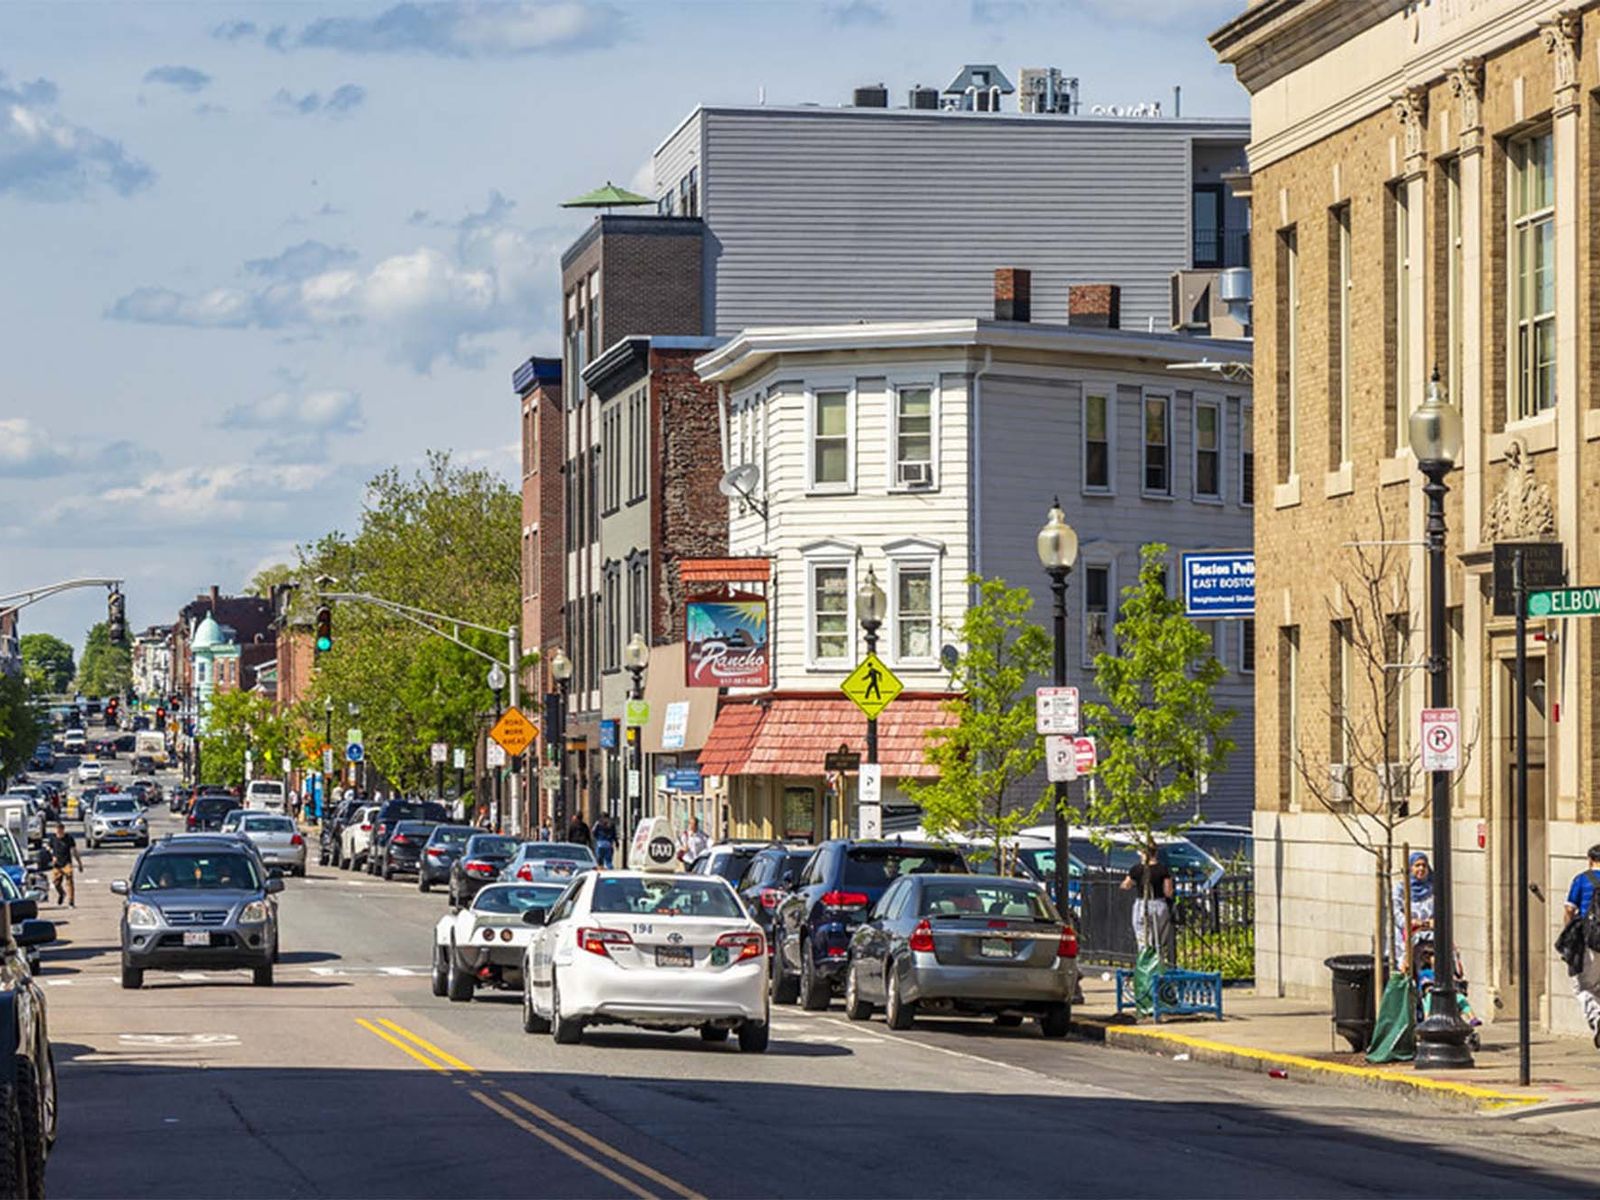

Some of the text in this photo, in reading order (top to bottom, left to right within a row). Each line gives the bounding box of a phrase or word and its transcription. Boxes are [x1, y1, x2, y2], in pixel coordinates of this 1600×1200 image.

[1192, 563, 1230, 575] Boston
[1192, 578, 1217, 589] EAST
[694, 641, 766, 681] Rancho
[651, 842, 673, 858] TAXI
